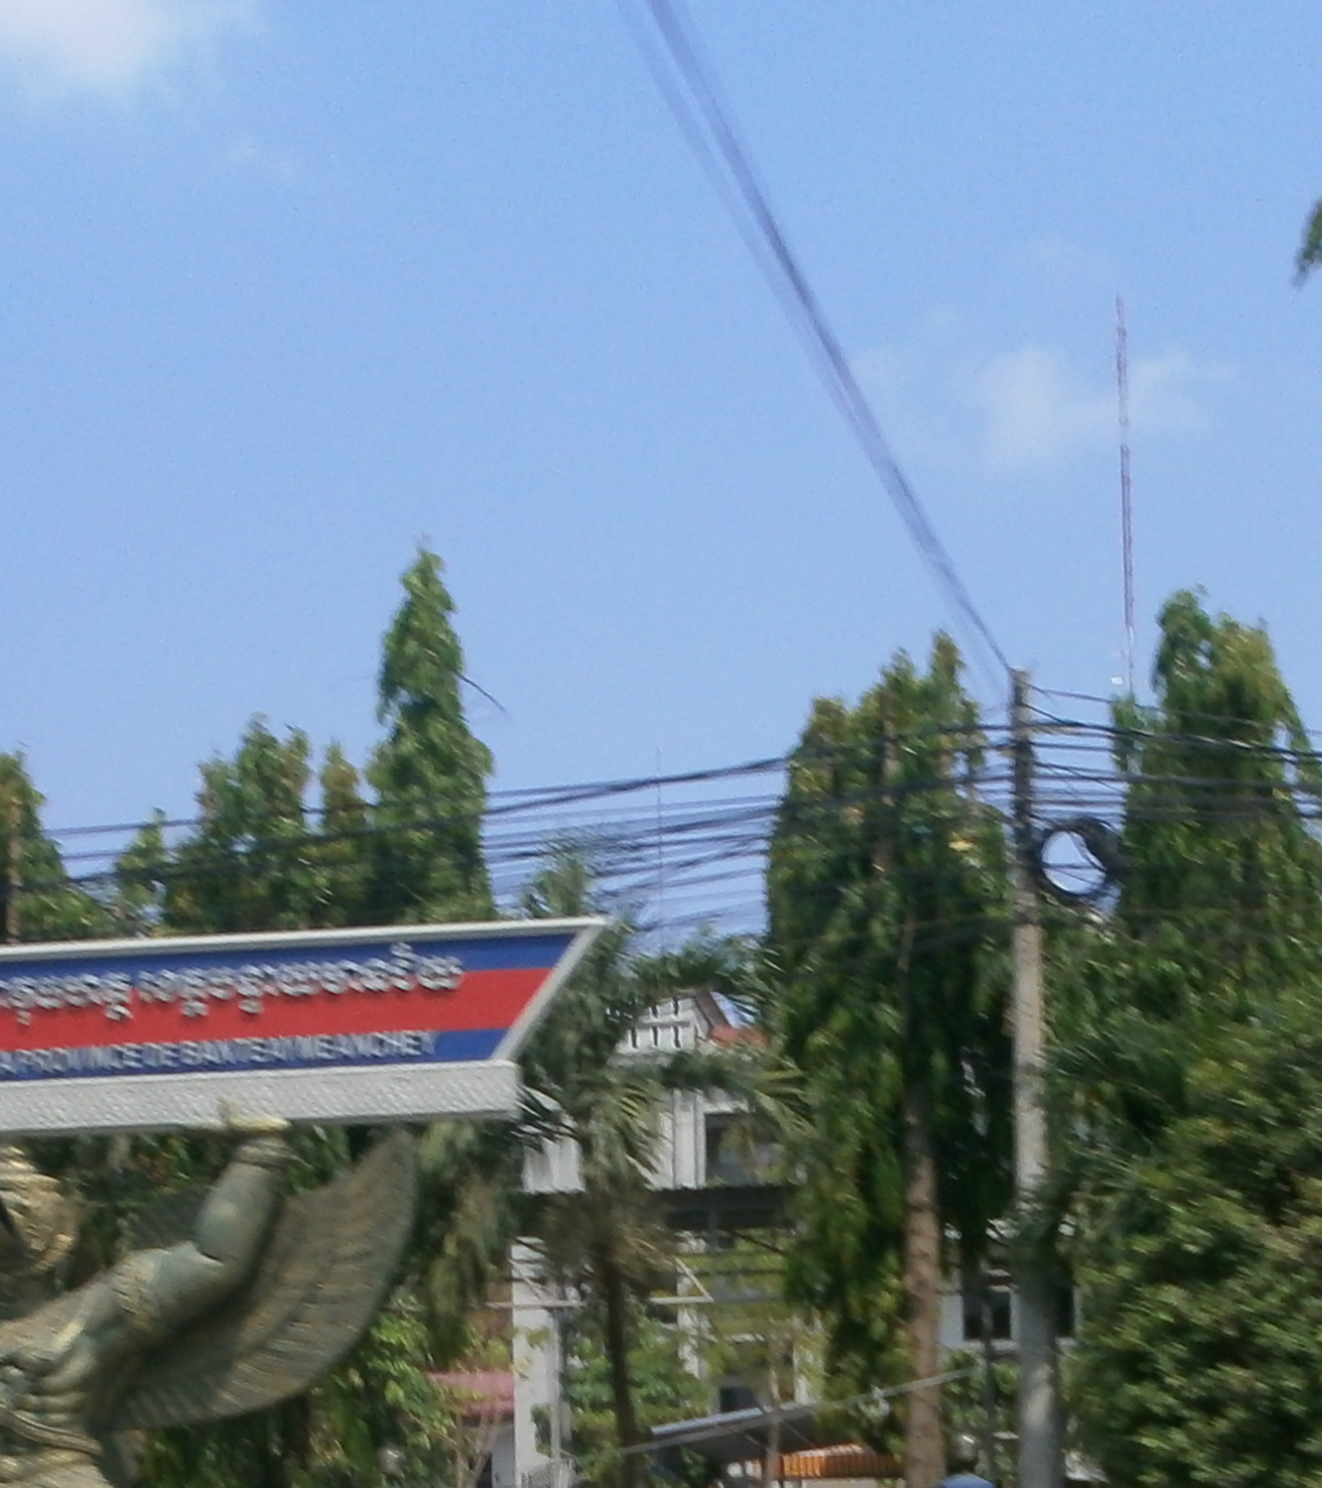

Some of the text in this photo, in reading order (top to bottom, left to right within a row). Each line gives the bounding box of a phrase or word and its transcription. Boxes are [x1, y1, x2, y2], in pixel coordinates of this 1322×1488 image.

[20, 1045, 143, 1075] PROVINCE
[146, 1043, 179, 1068] DE
[182, 1036, 299, 1066] BANTEAY
[300, 1030, 436, 1061] MEANCHEY
